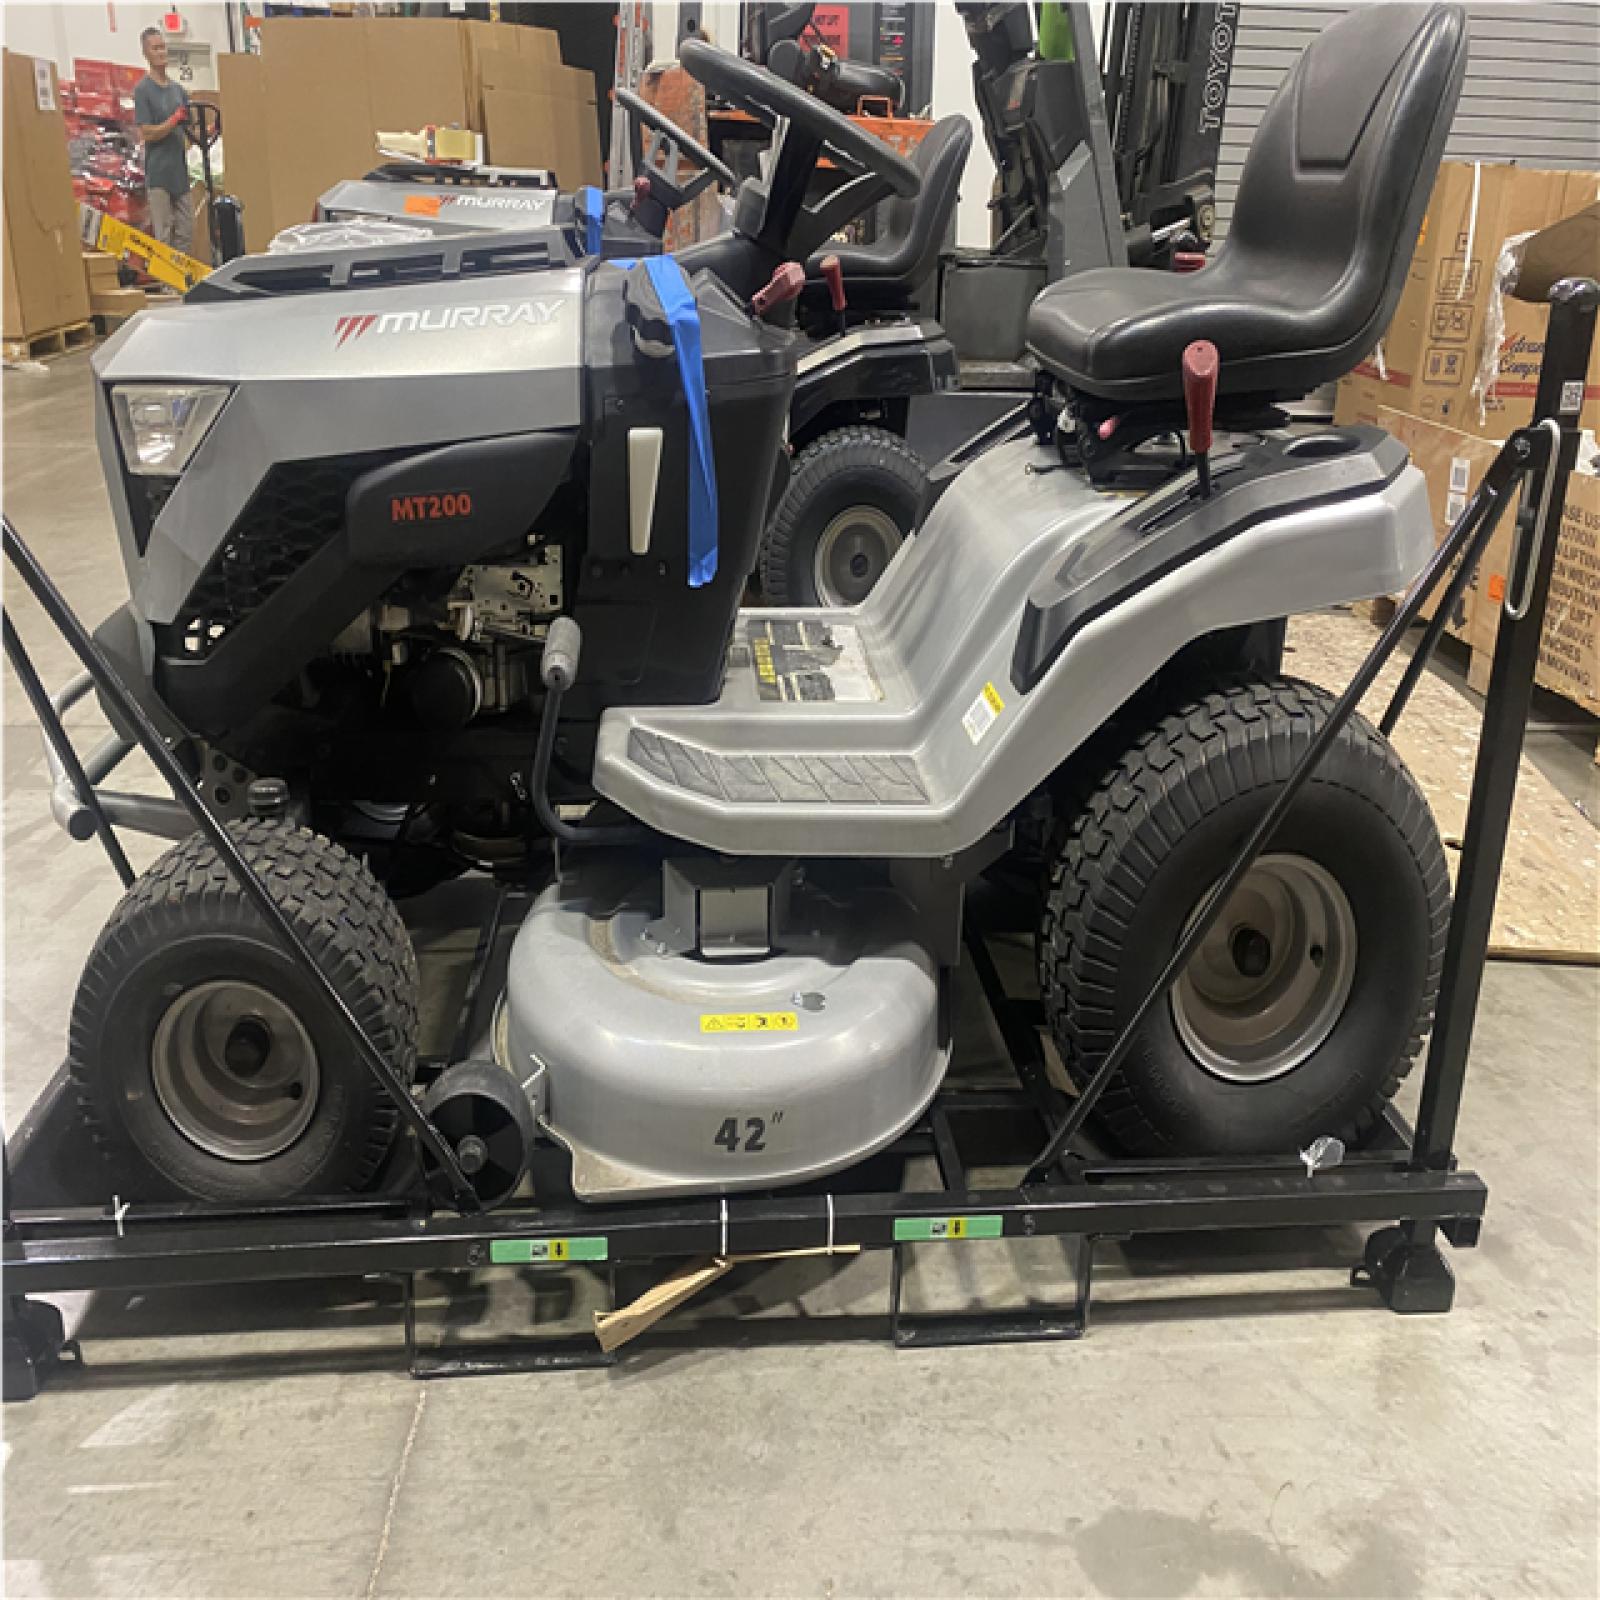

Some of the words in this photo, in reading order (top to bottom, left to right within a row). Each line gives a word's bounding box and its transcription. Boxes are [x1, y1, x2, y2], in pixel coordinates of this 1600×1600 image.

[457, 194, 545, 211] MURRAY
[376, 299, 567, 335] MURRAY
[391, 493, 472, 522] MT200
